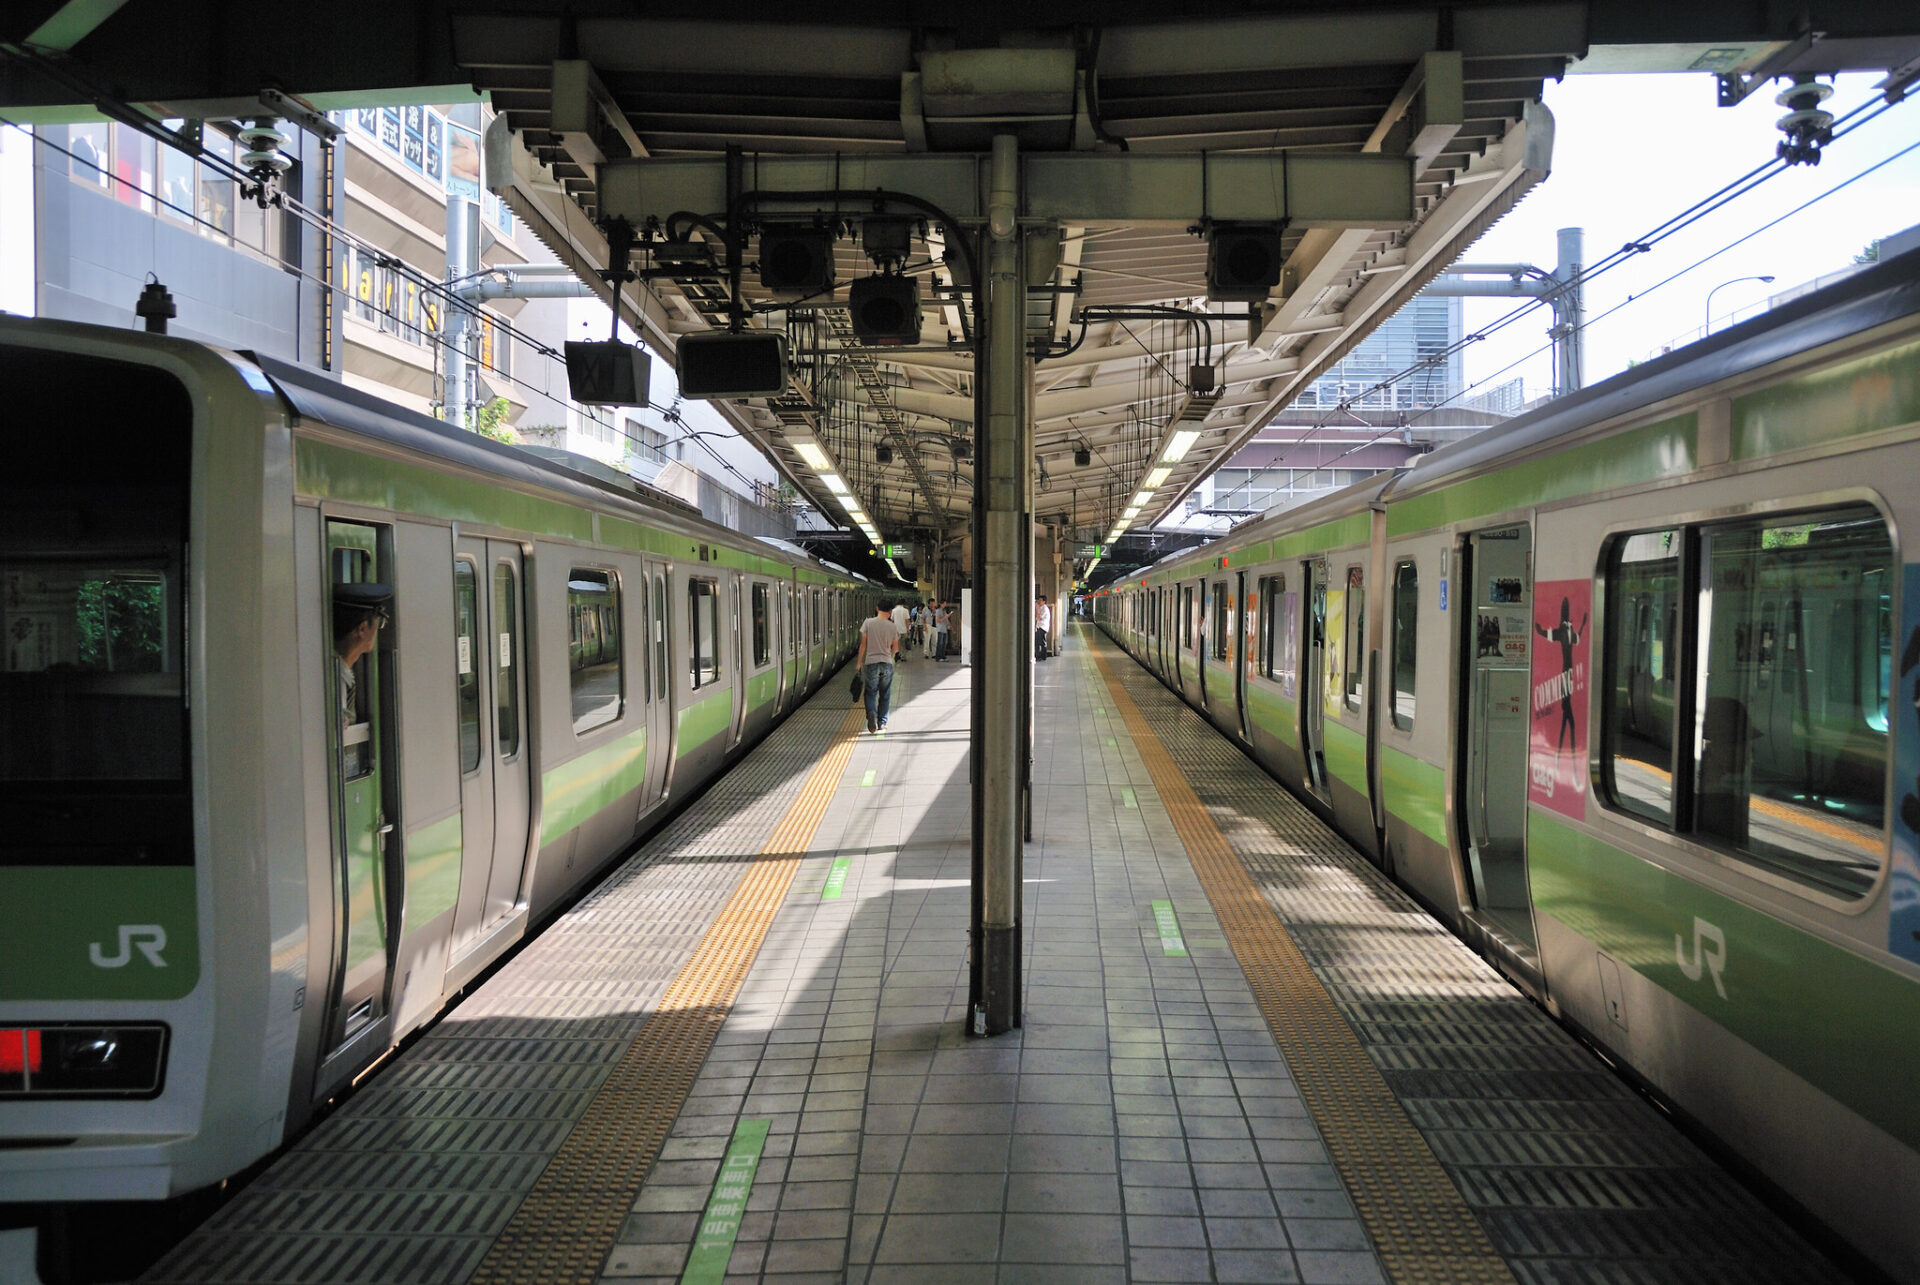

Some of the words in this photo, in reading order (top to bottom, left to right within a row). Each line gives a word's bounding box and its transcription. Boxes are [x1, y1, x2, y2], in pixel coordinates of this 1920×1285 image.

[881, 545, 886, 556] 1
[1101, 545, 1108, 556] 2
[1534, 668, 1574, 711] COMMING
[89, 924, 167, 967] JR
[1675, 916, 1727, 1000] JR
